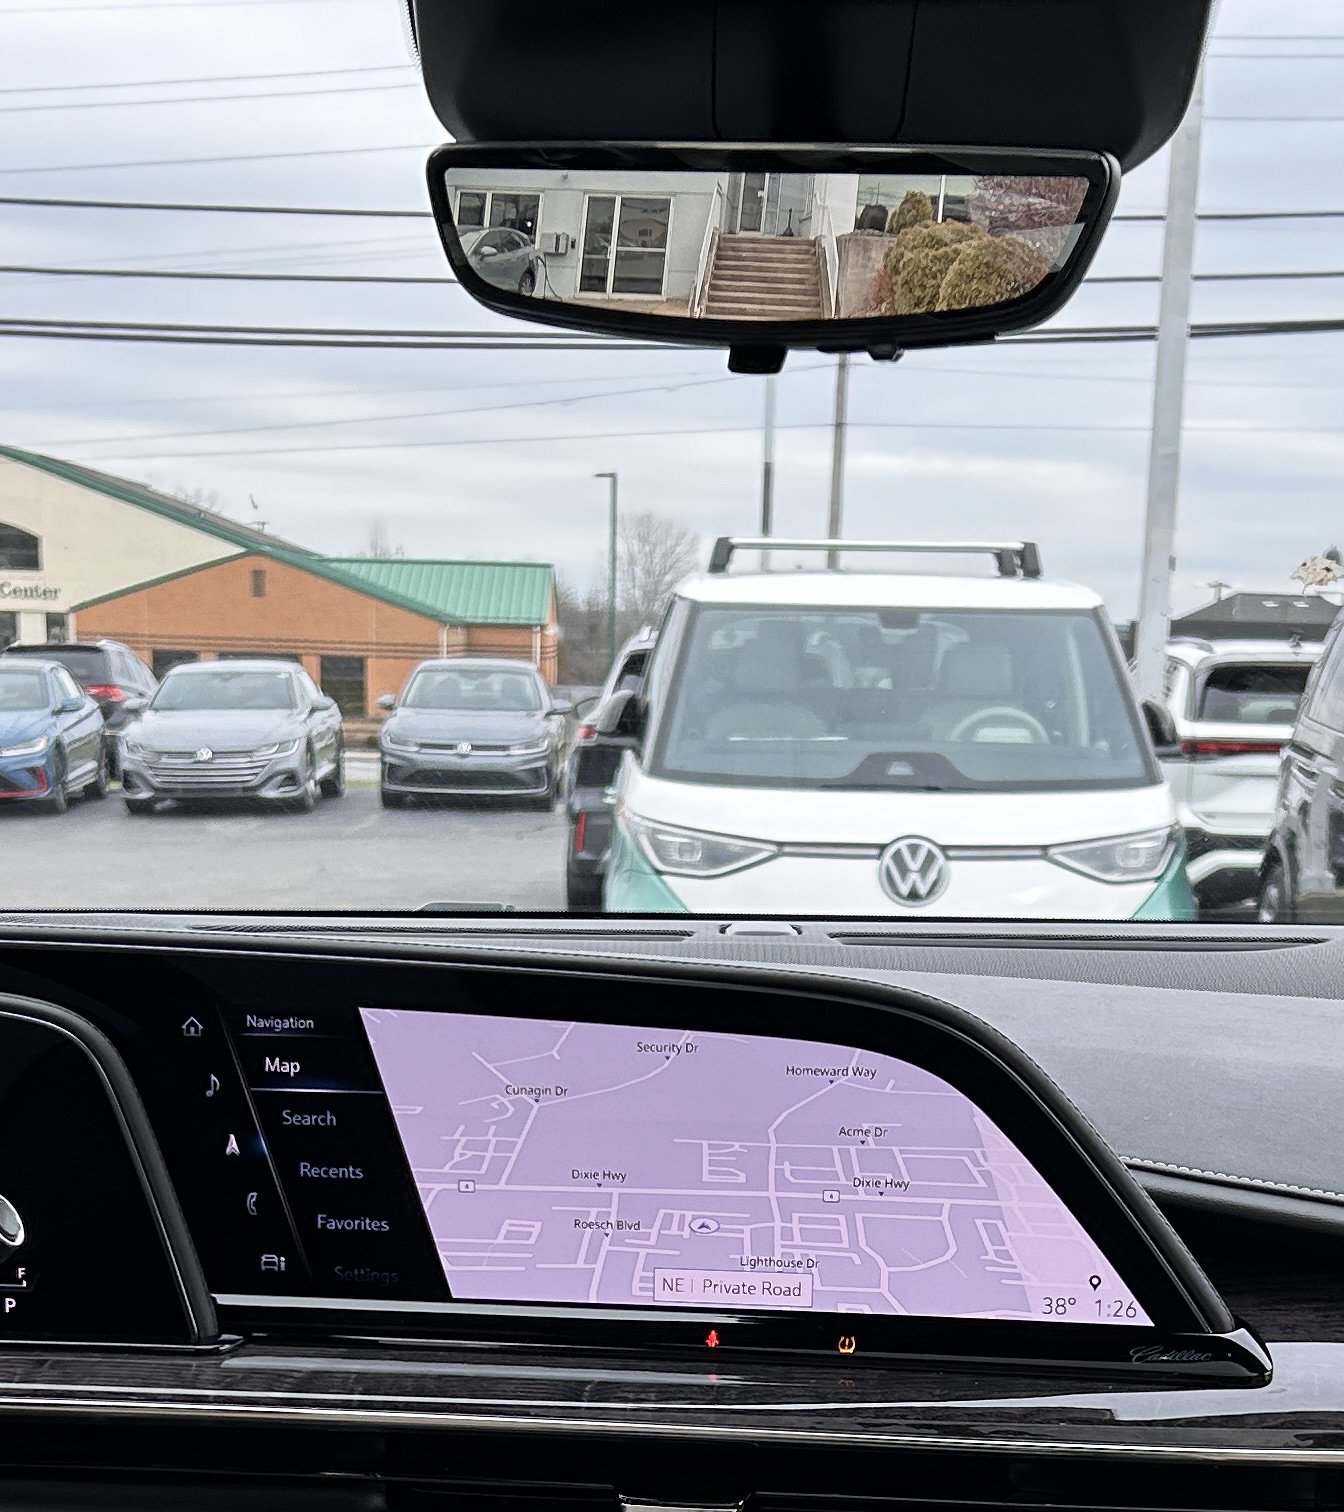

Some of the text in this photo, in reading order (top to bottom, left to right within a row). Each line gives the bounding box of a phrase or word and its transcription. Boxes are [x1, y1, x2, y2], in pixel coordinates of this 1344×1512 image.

[245, 1014, 315, 1032] Navigation
[636, 1041, 699, 1055] Security Dr
[264, 1056, 301, 1077] Map
[786, 1065, 877, 1080] Homeward Way
[505, 1084, 568, 1098] Cunagin Dr
[281, 1109, 337, 1127] Search
[838, 1126, 889, 1138] Acme Dr
[299, 1162, 364, 1180] Recents
[571, 1168, 627, 1183] Dixie Hwy
[852, 1177, 910, 1191] Dixie Hwy
[316, 1213, 390, 1232] Favorites
[573, 1218, 641, 1232] Roesch Blvd
[740, 1256, 820, 1270] Lighthouse Dr
[17, 1268, 26, 1280] F
[333, 1265, 400, 1287] Settings
[662, 1277, 803, 1297] NE Private Road
[4, 1297, 17, 1313] P
[1041, 1296, 1138, 1318] 38° 1:26
[1129, 1345, 1213, 1365] Cadillac
